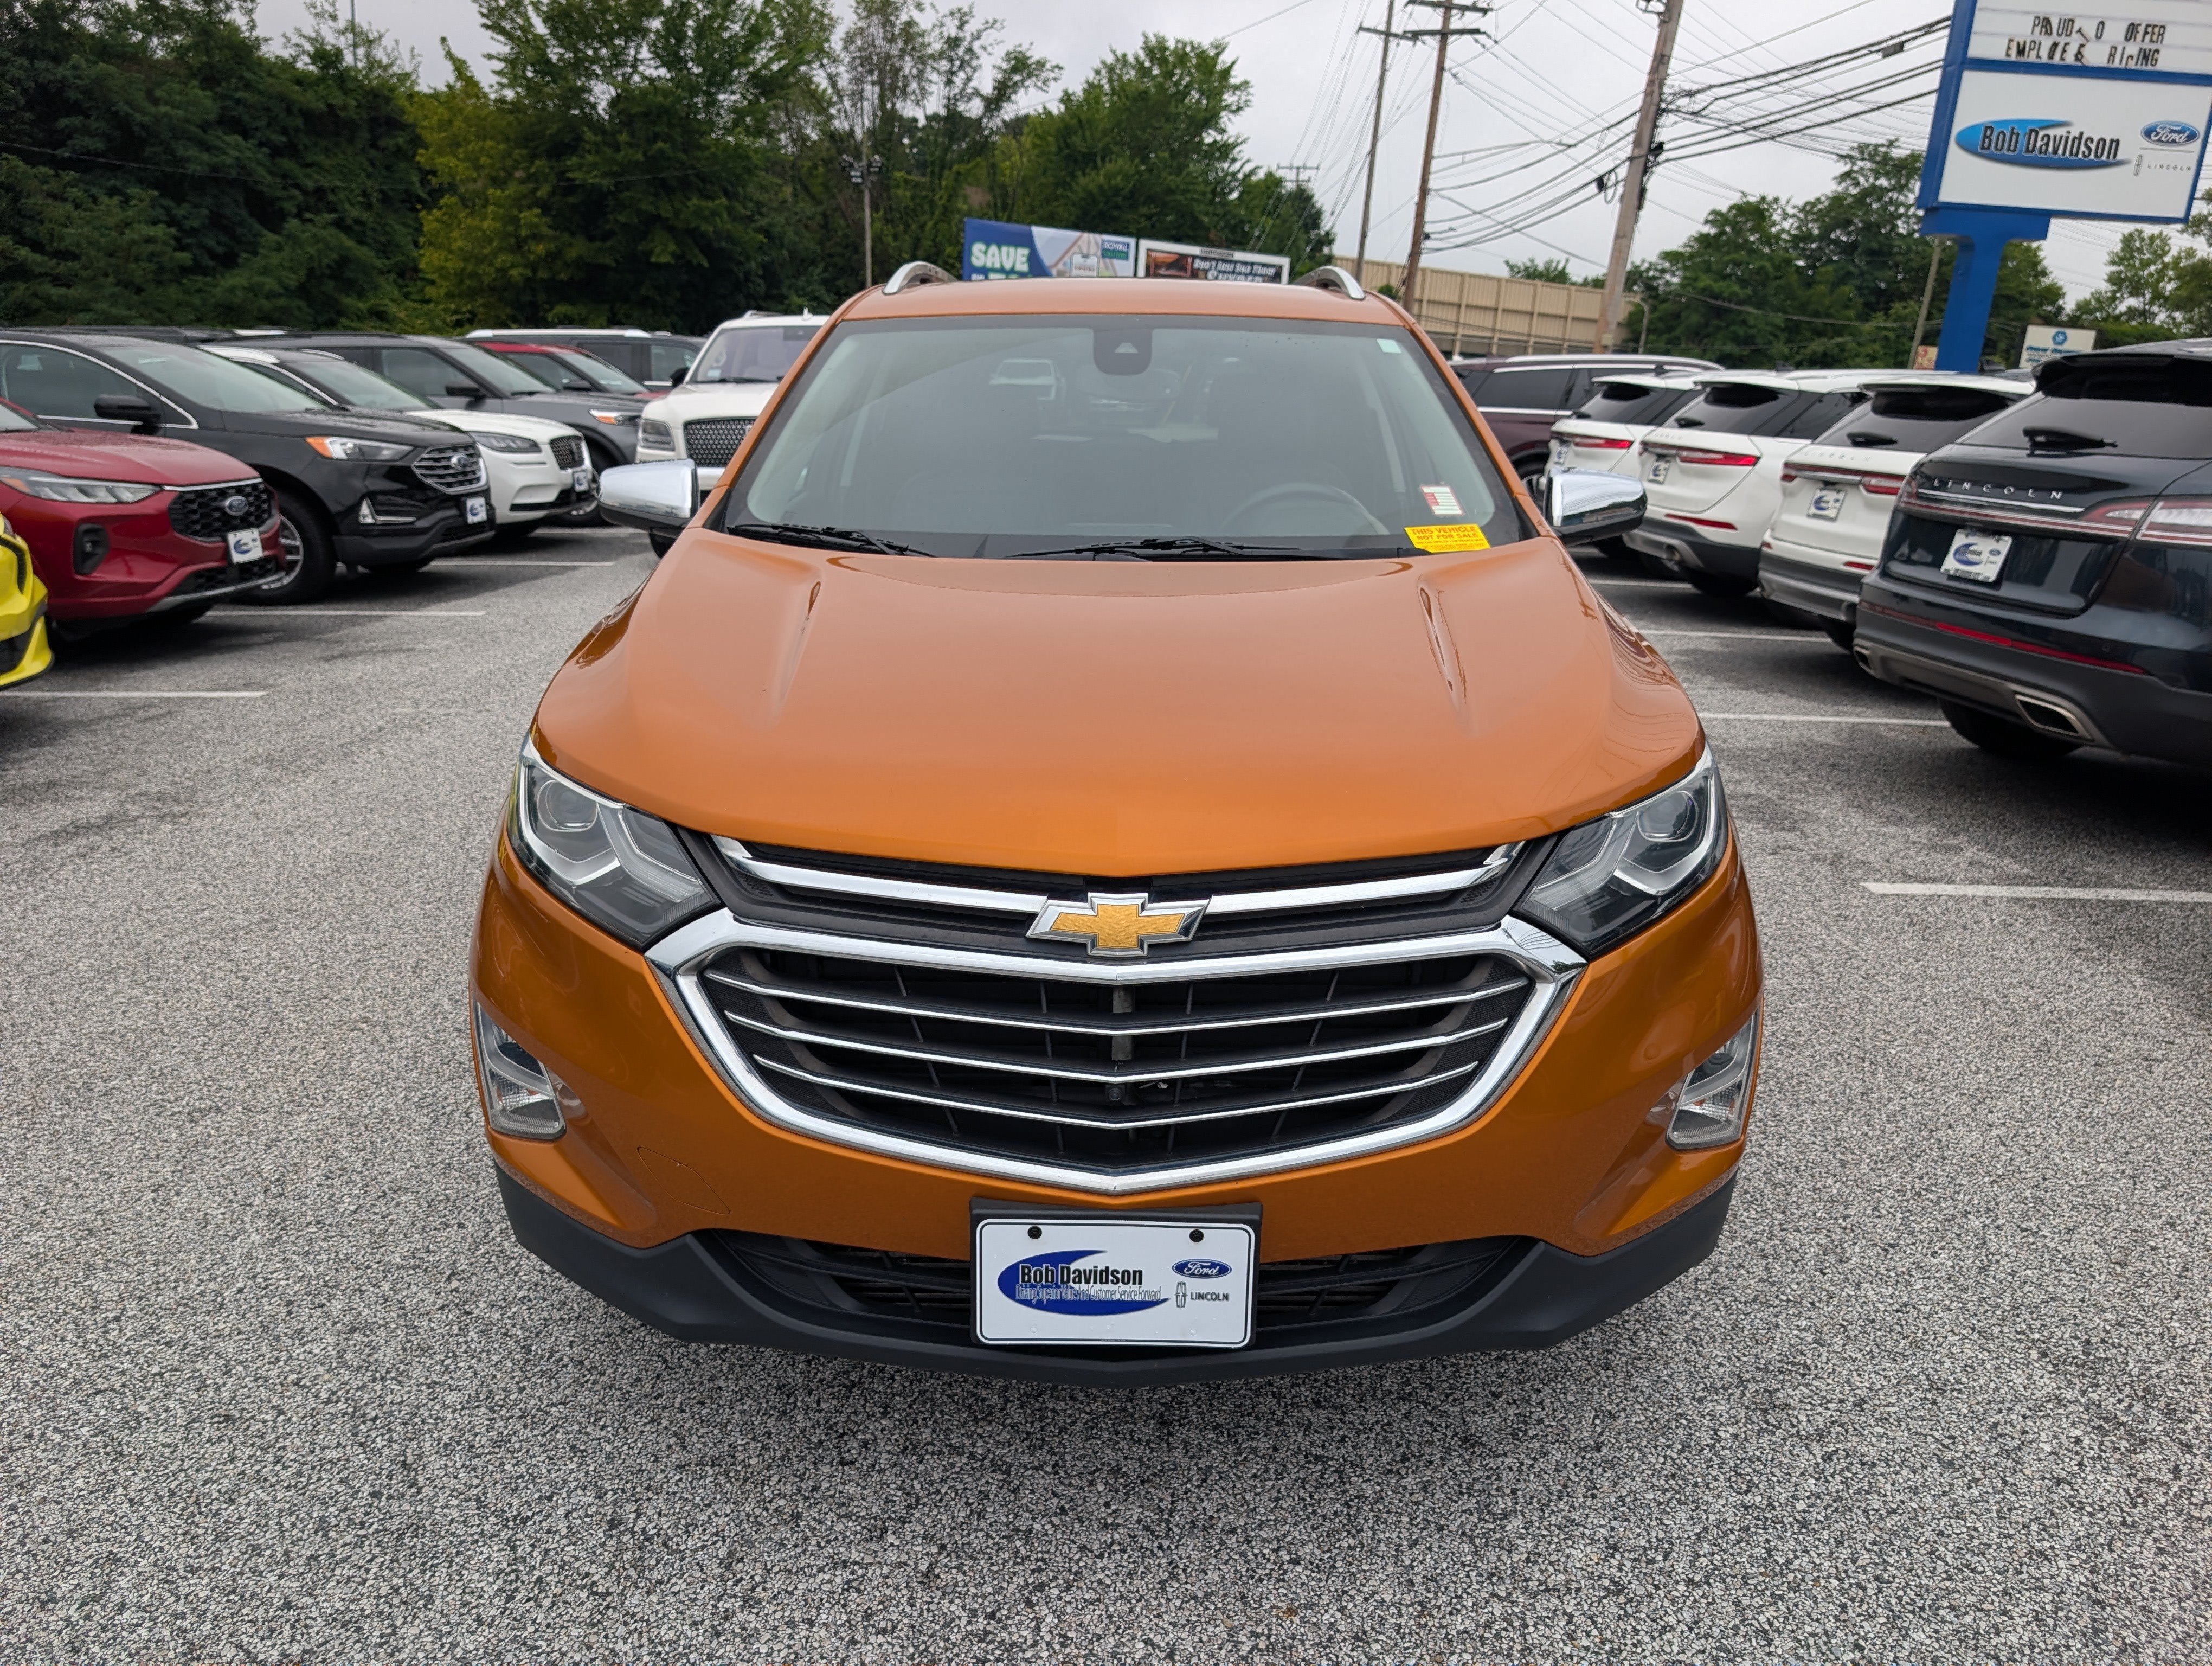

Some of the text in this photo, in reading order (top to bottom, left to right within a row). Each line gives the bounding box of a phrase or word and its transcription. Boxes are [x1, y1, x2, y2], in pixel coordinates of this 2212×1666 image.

[2124, 22, 2167, 44] OFFER
[1978, 124, 2121, 162] Bob Davidson
[2150, 124, 2191, 143] Ford
[970, 241, 1030, 272] SAVE
[1934, 478, 2063, 501] LINCOLN
[1019, 1264, 1143, 1285] Bob Davidson
[1184, 1261, 1220, 1276] Ford
[1089, 1285, 1118, 1300] Customer
[1117, 1286, 1137, 1301] Service
[1139, 1286, 1161, 1302] Forward
[1190, 1291, 1230, 1302] LINCOLN
